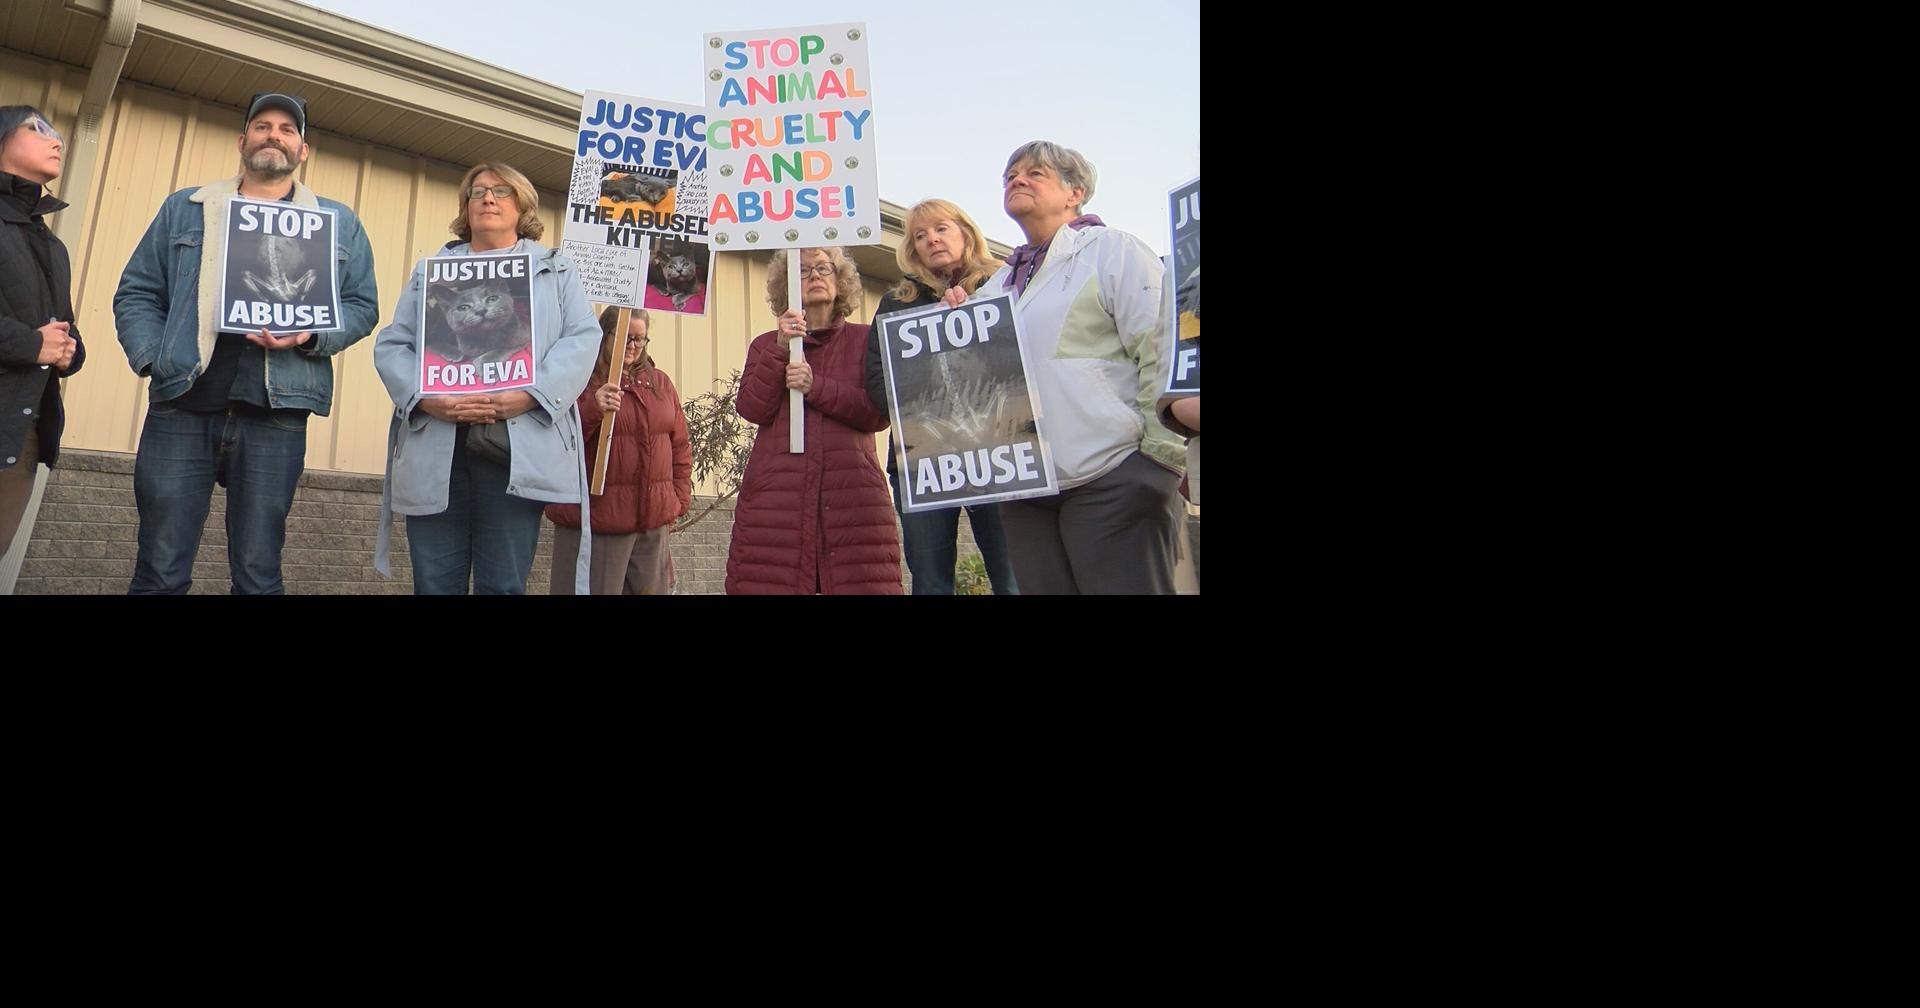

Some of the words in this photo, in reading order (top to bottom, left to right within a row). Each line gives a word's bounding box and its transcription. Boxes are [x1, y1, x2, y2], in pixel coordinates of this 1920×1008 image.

[724, 35, 825, 70] STOP
[719, 68, 867, 108] ANIMAL
[586, 99, 706, 142] JUSTIC
[706, 109, 871, 150] CRUELTY
[577, 130, 646, 165] FOR
[743, 151, 833, 185] AND
[239, 204, 323, 239] STOP
[570, 203, 614, 225] THE
[618, 208, 708, 236] ABUSED
[708, 185, 855, 225] ABUSE!
[607, 226, 689, 251] KITTEN
[429, 259, 525, 282] JUSTICE
[228, 300, 331, 326] ABUSE
[899, 304, 1000, 359] STOP
[427, 364, 476, 386] FOR
[483, 359, 528, 384] EVA
[916, 441, 1038, 495] ABUSE
